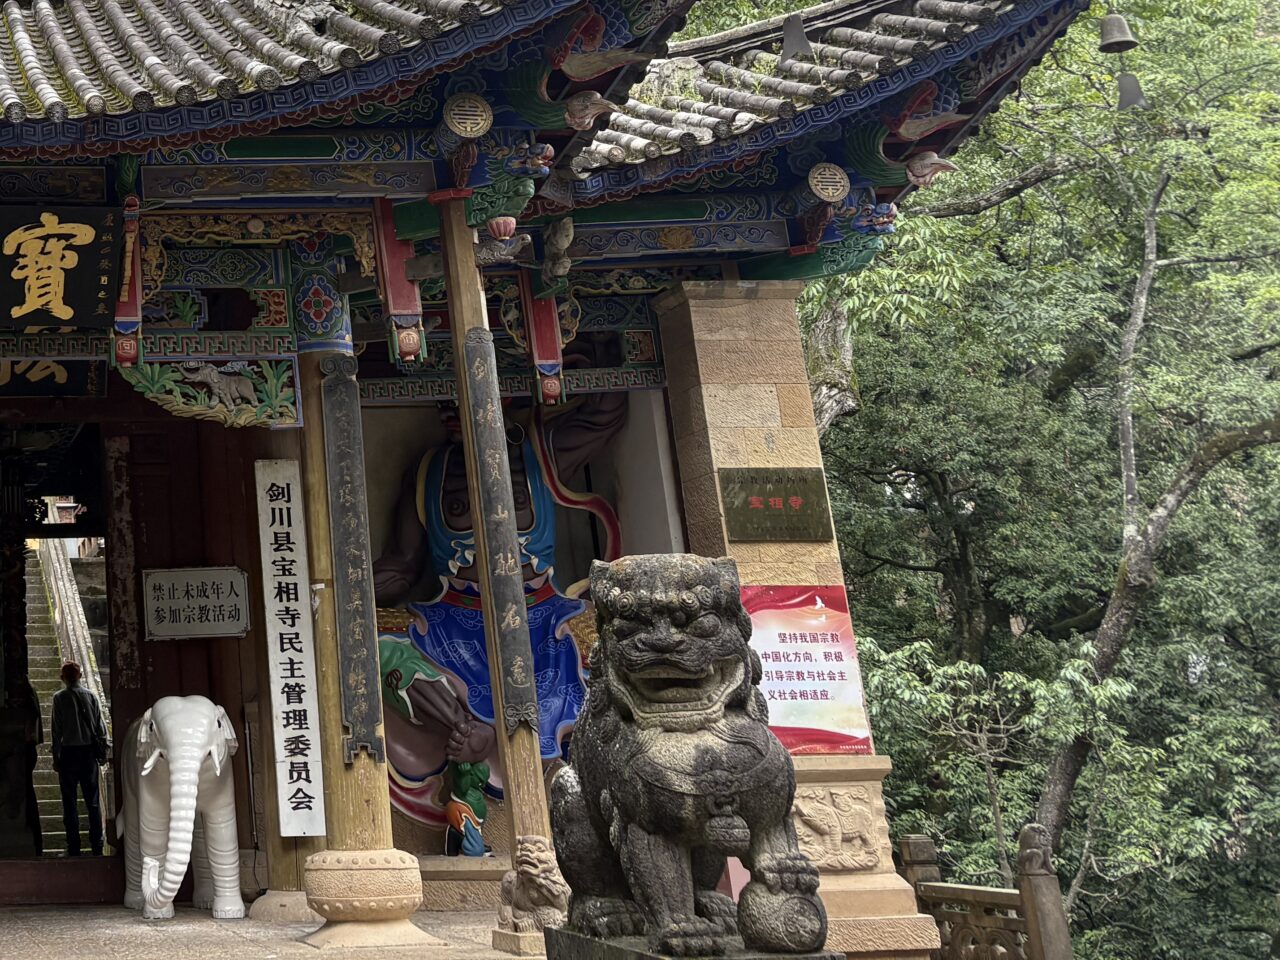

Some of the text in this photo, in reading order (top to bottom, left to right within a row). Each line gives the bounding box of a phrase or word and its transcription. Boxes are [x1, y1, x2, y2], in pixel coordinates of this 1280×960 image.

[152, 581, 240, 602] 禁止未成年人
[154, 603, 241, 625] 参加宗教活动
[777, 632, 841, 644] 坚持我国宗教
[265, 482, 316, 812] 剑川县宝相寺民主管理委员会
[764, 670, 848, 682] 引导宗教与社会主
[767, 689, 836, 701] 义社会相适应。
